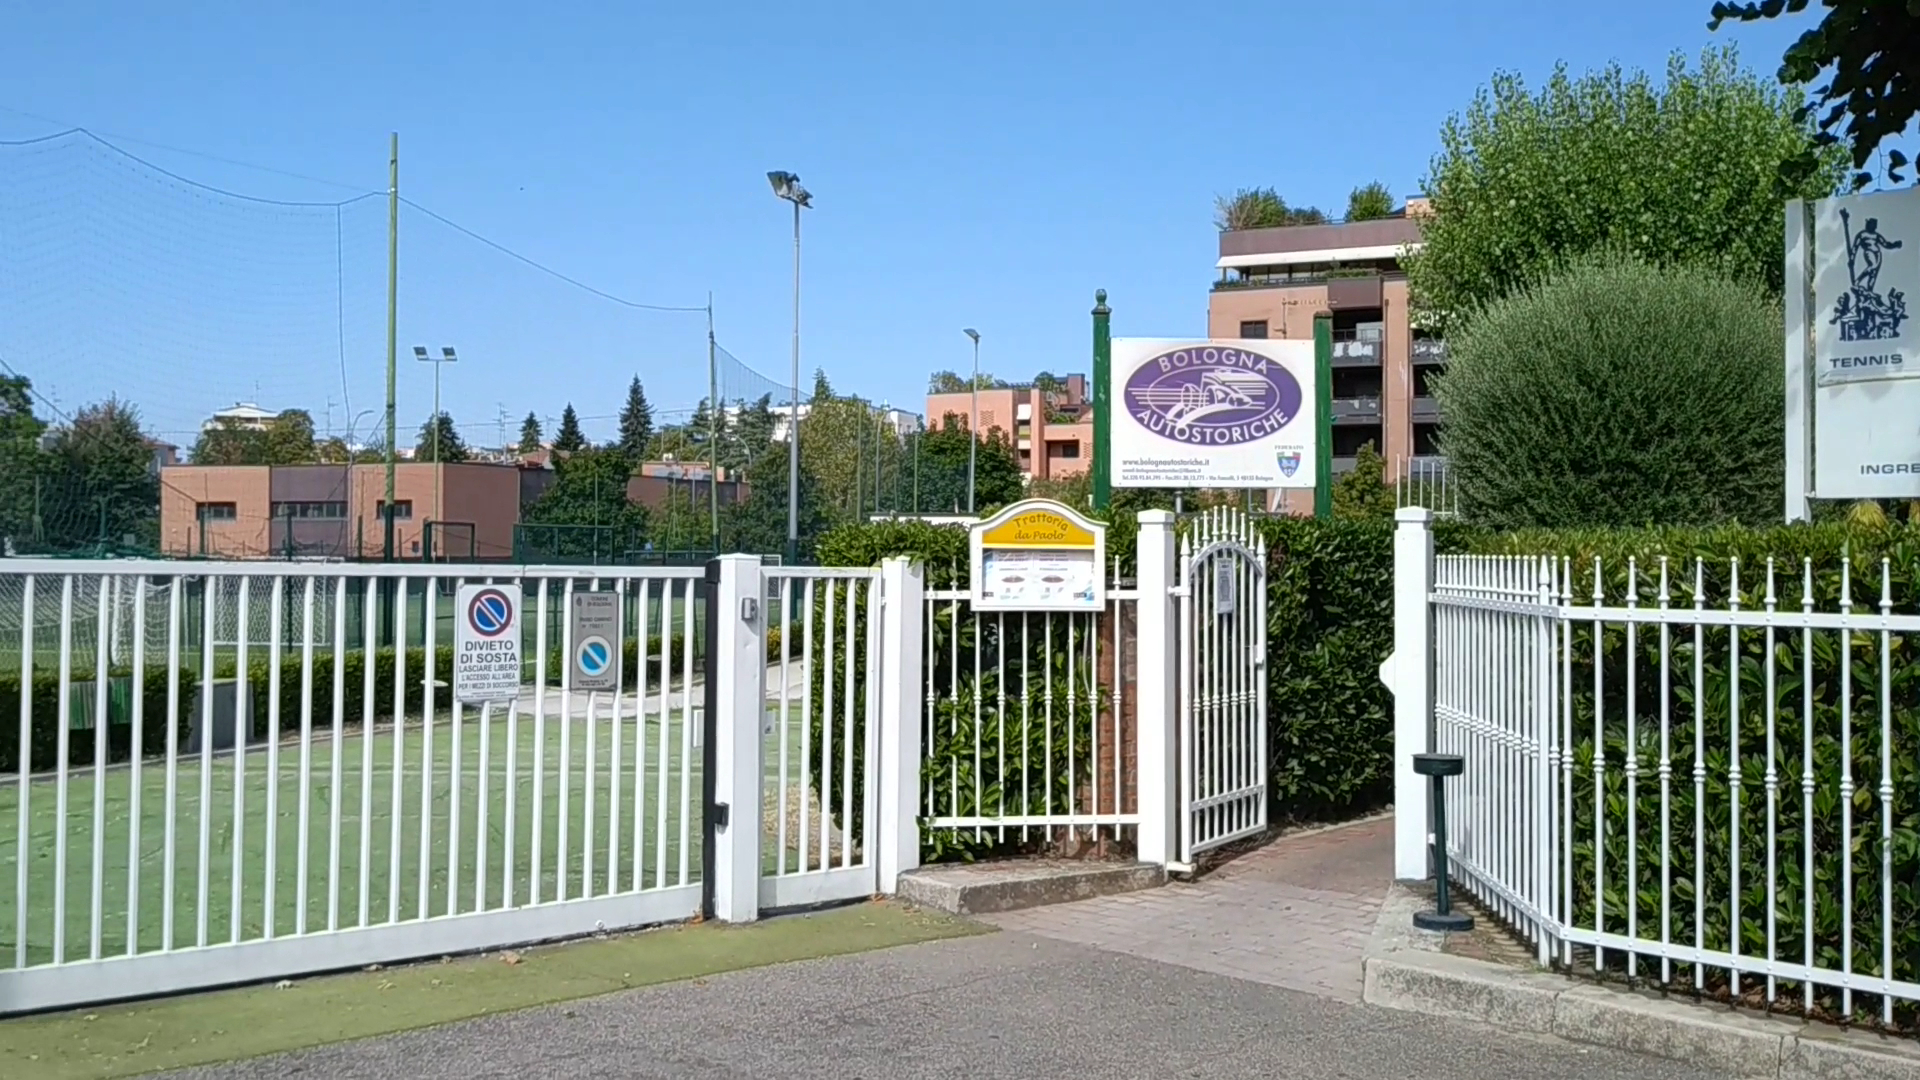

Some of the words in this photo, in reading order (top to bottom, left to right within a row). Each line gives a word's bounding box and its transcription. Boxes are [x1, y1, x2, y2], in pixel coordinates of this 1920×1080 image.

[1158, 348, 1268, 375] BOLOGNA
[1829, 354, 1903, 369] TENNIS
[1136, 408, 1289, 445] AUTOSTORICHE
[1122, 457, 1210, 468] www.bolognautostoriche.it
[1860, 463, 1920, 475] INGRE
[1013, 513, 1068, 531] Trattoria
[1014, 530, 1031, 540] da
[1033, 530, 1065, 540] Paolo
[465, 640, 514, 651] DIVIETO
[460, 653, 473, 664] DI
[476, 652, 517, 663] SOSTA
[458, 664, 492, 673] LASCIARE
[493, 663, 519, 672] LIBERO
[461, 673, 490, 681] L'ACCESSO
[491, 672, 516, 680] ALL'AREA
[492, 681, 519, 689] SOCCORSO
